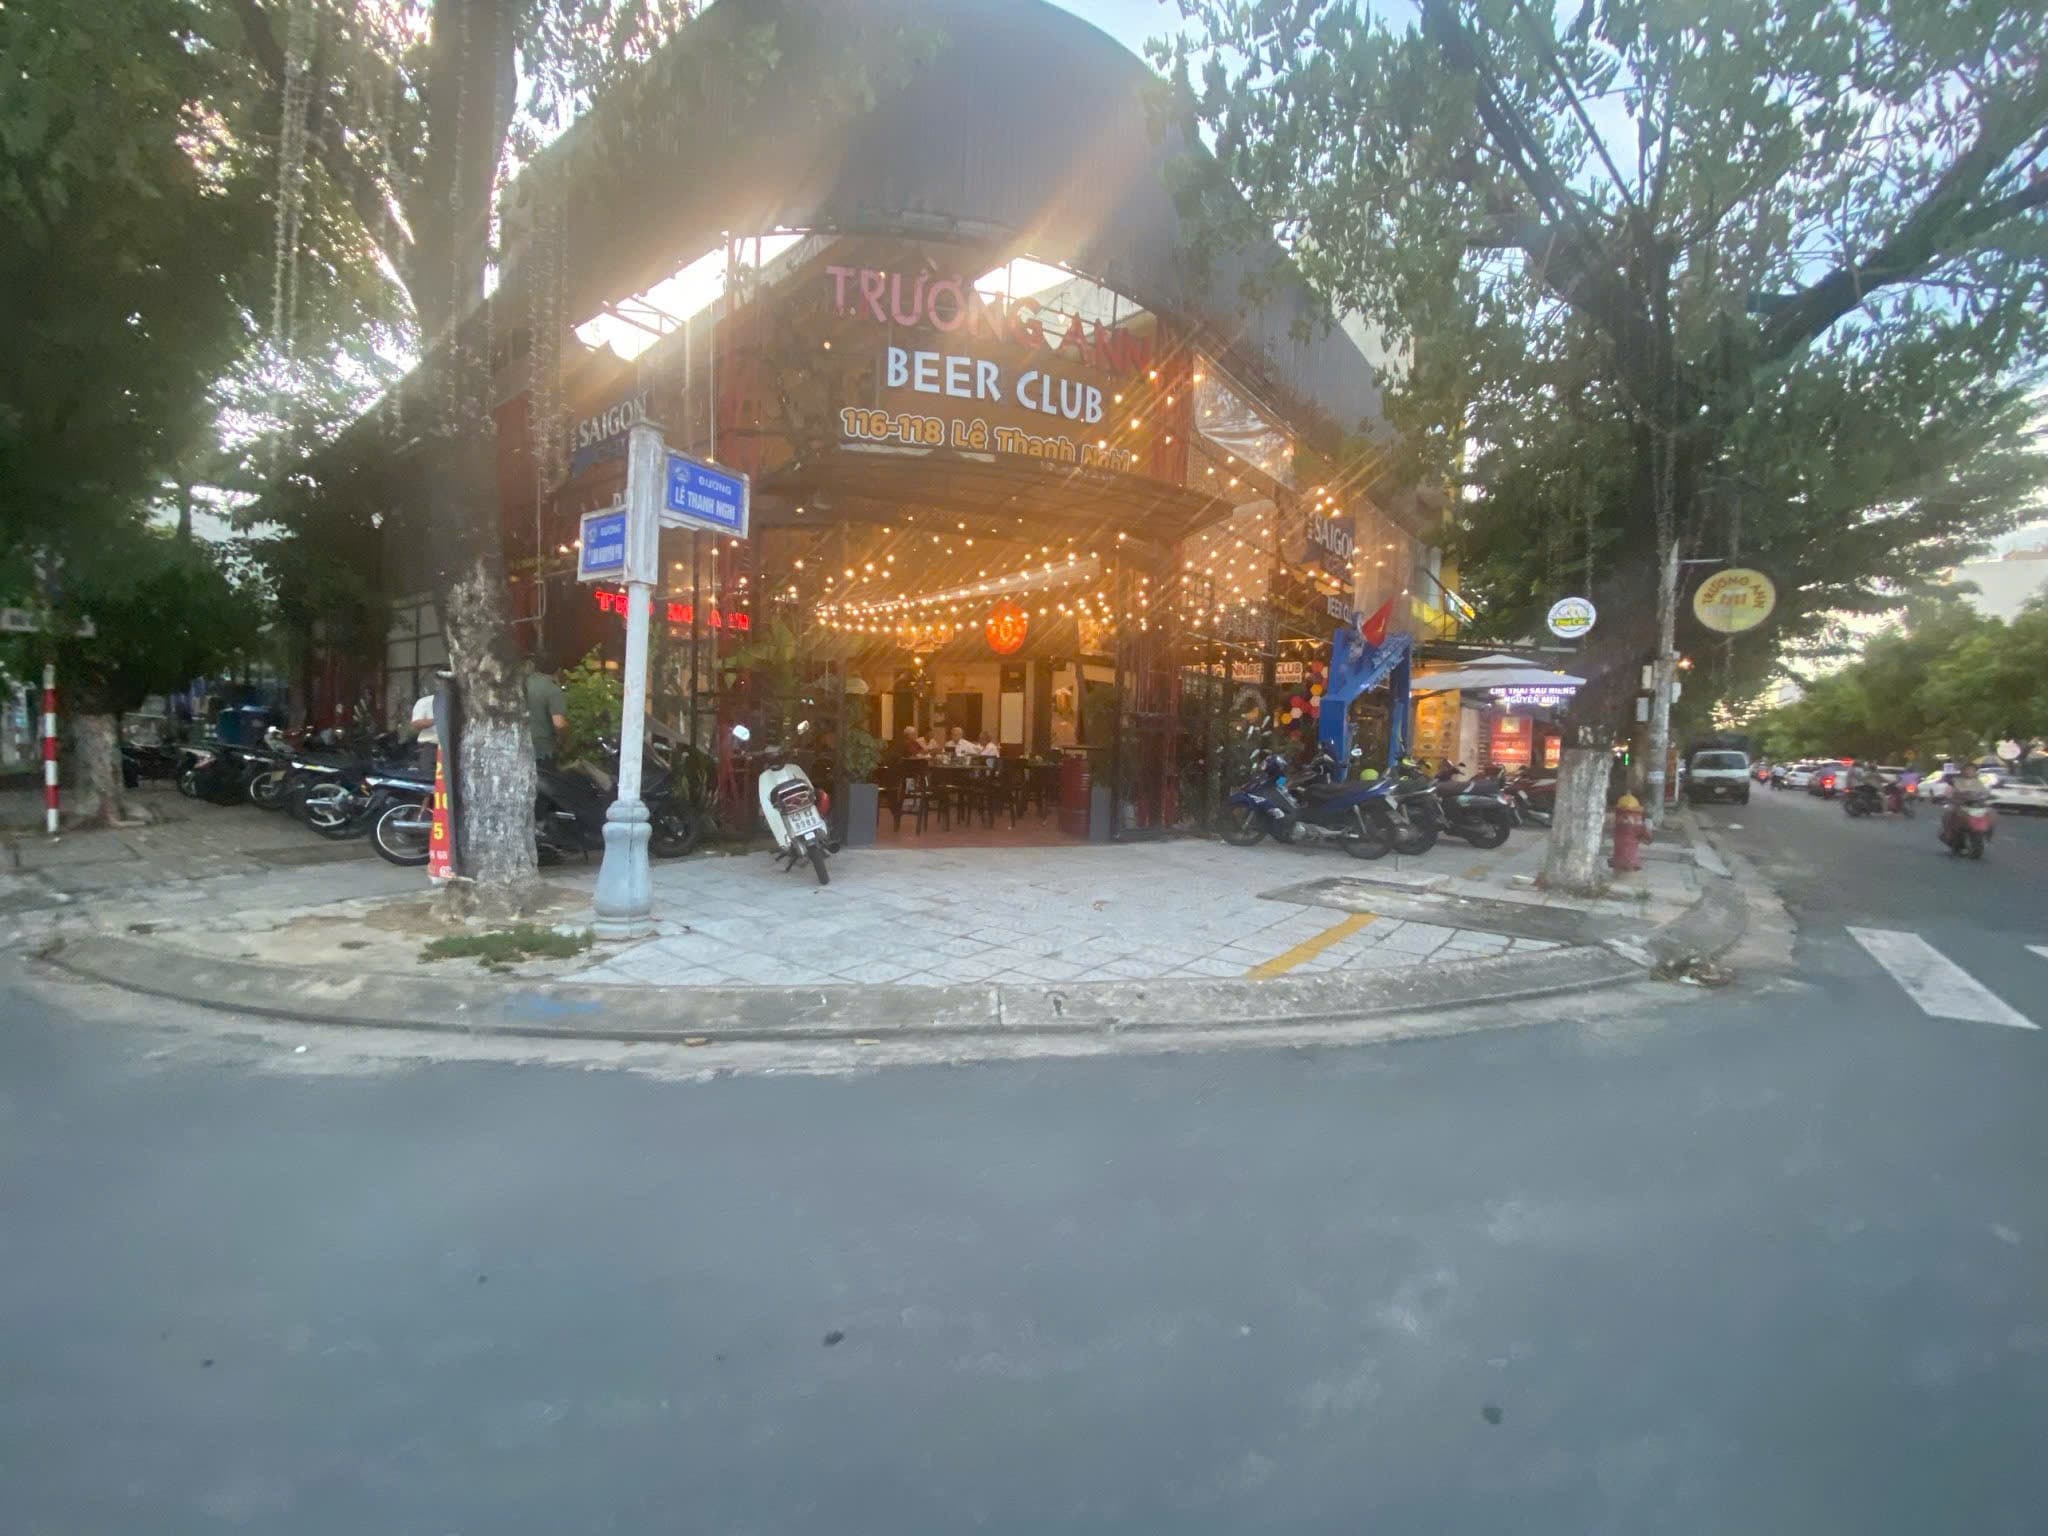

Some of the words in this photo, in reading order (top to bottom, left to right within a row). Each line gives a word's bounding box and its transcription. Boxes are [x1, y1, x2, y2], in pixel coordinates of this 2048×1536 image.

[887, 346, 1001, 401] BEER
[1016, 371, 1103, 423] CLUB
[579, 392, 648, 448] SAIGON
[840, 407, 945, 446] 116-118
[951, 418, 988, 450] Lê
[994, 427, 1076, 462] Thanh
[675, 485, 685, 505] LÊ
[687, 491, 714, 514] THANH
